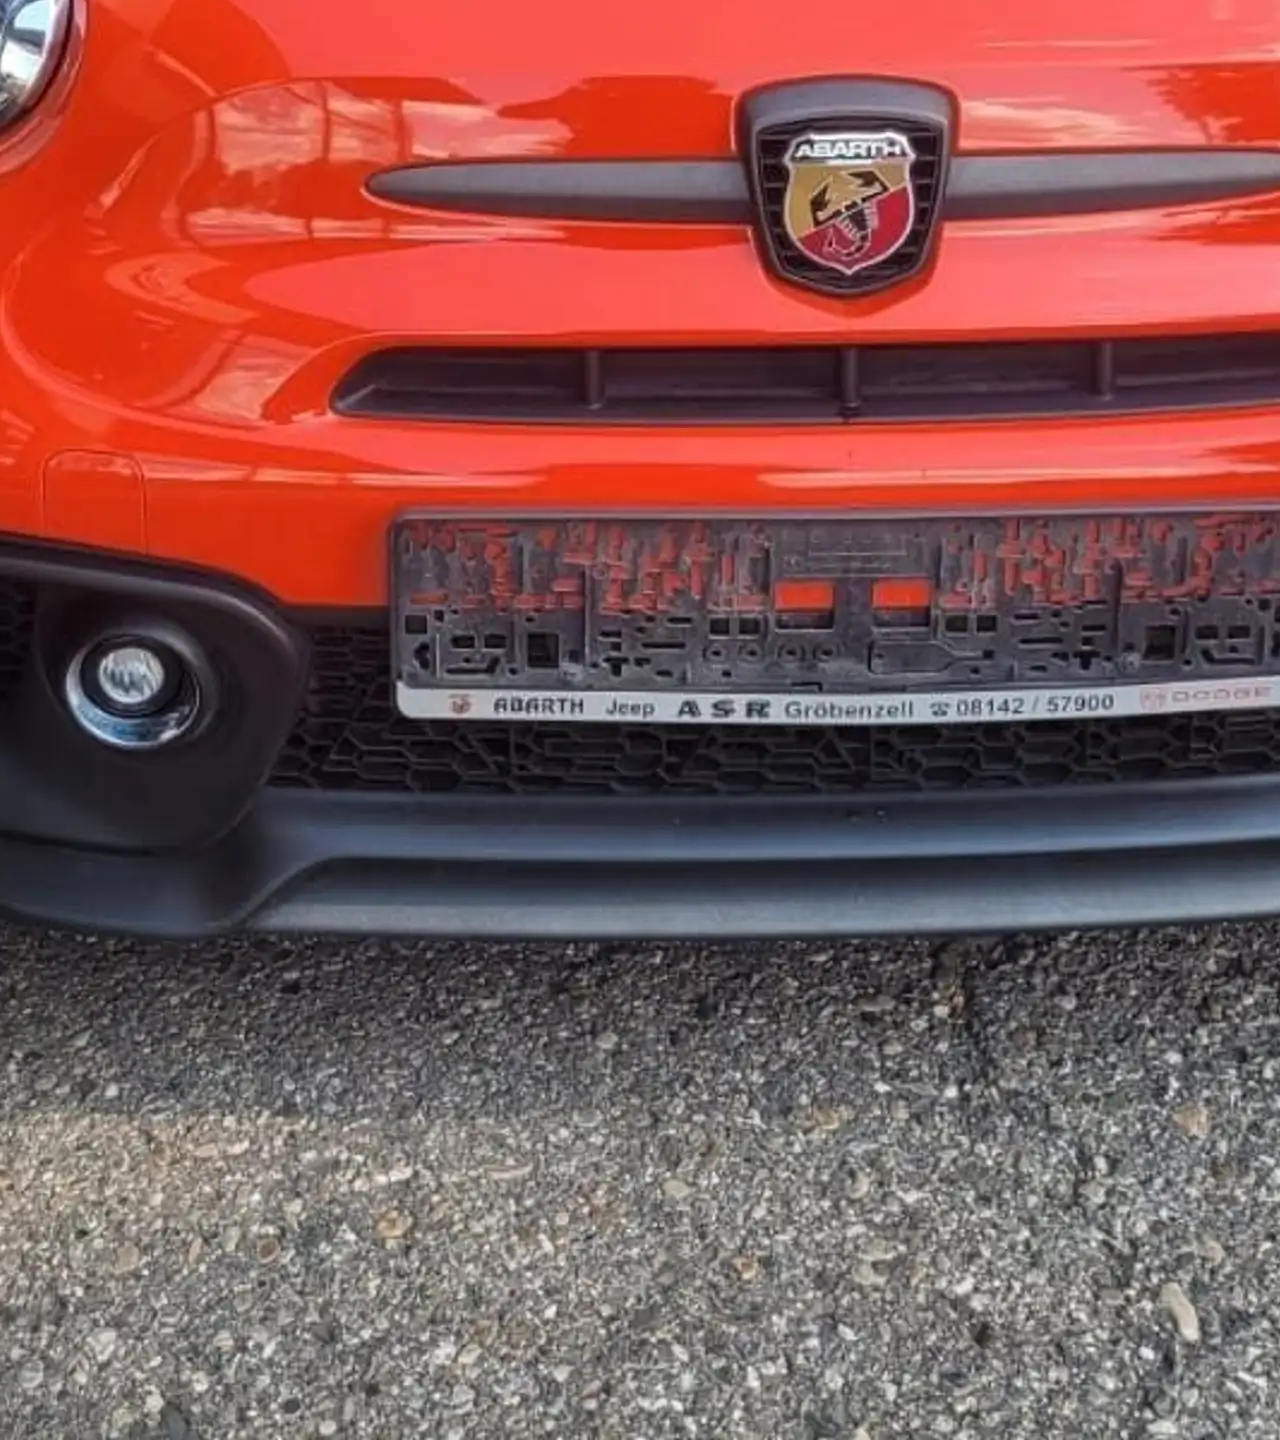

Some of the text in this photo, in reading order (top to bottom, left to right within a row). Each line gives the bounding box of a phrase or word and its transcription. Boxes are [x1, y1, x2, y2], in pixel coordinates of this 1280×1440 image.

[794, 140, 902, 159] ABARTH
[493, 696, 584, 714] ABARTH
[606, 698, 655, 719] Jeep
[956, 697, 1025, 717] 08142
[1046, 693, 1115, 714] 57900
